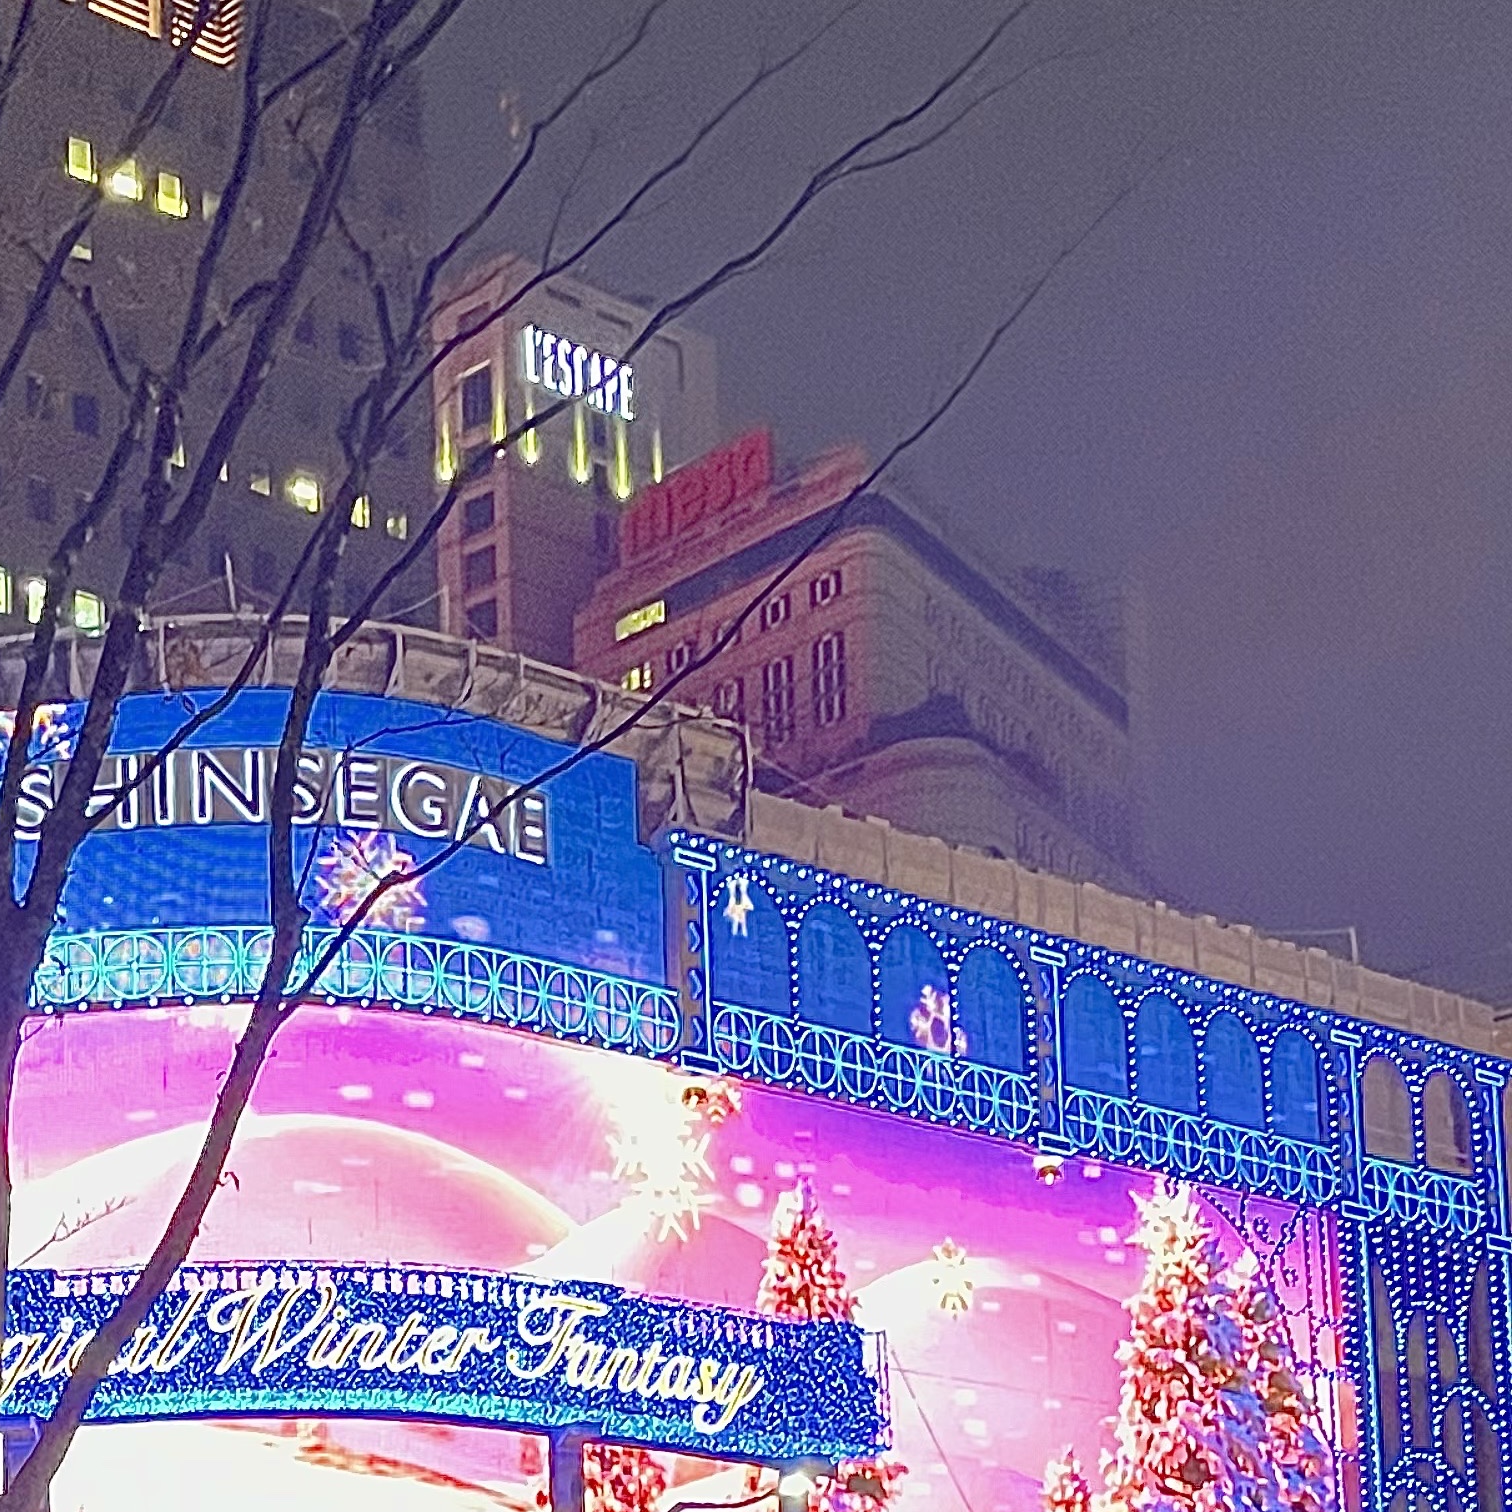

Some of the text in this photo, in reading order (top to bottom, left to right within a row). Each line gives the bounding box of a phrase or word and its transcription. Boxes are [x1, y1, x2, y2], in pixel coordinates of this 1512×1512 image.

[524, 323, 635, 422] L'ESCAPE
[13, 748, 547, 865] SHINSEGAE
[206, 1283, 501, 1376] Winter
[506, 1294, 765, 1435] Fantasy
